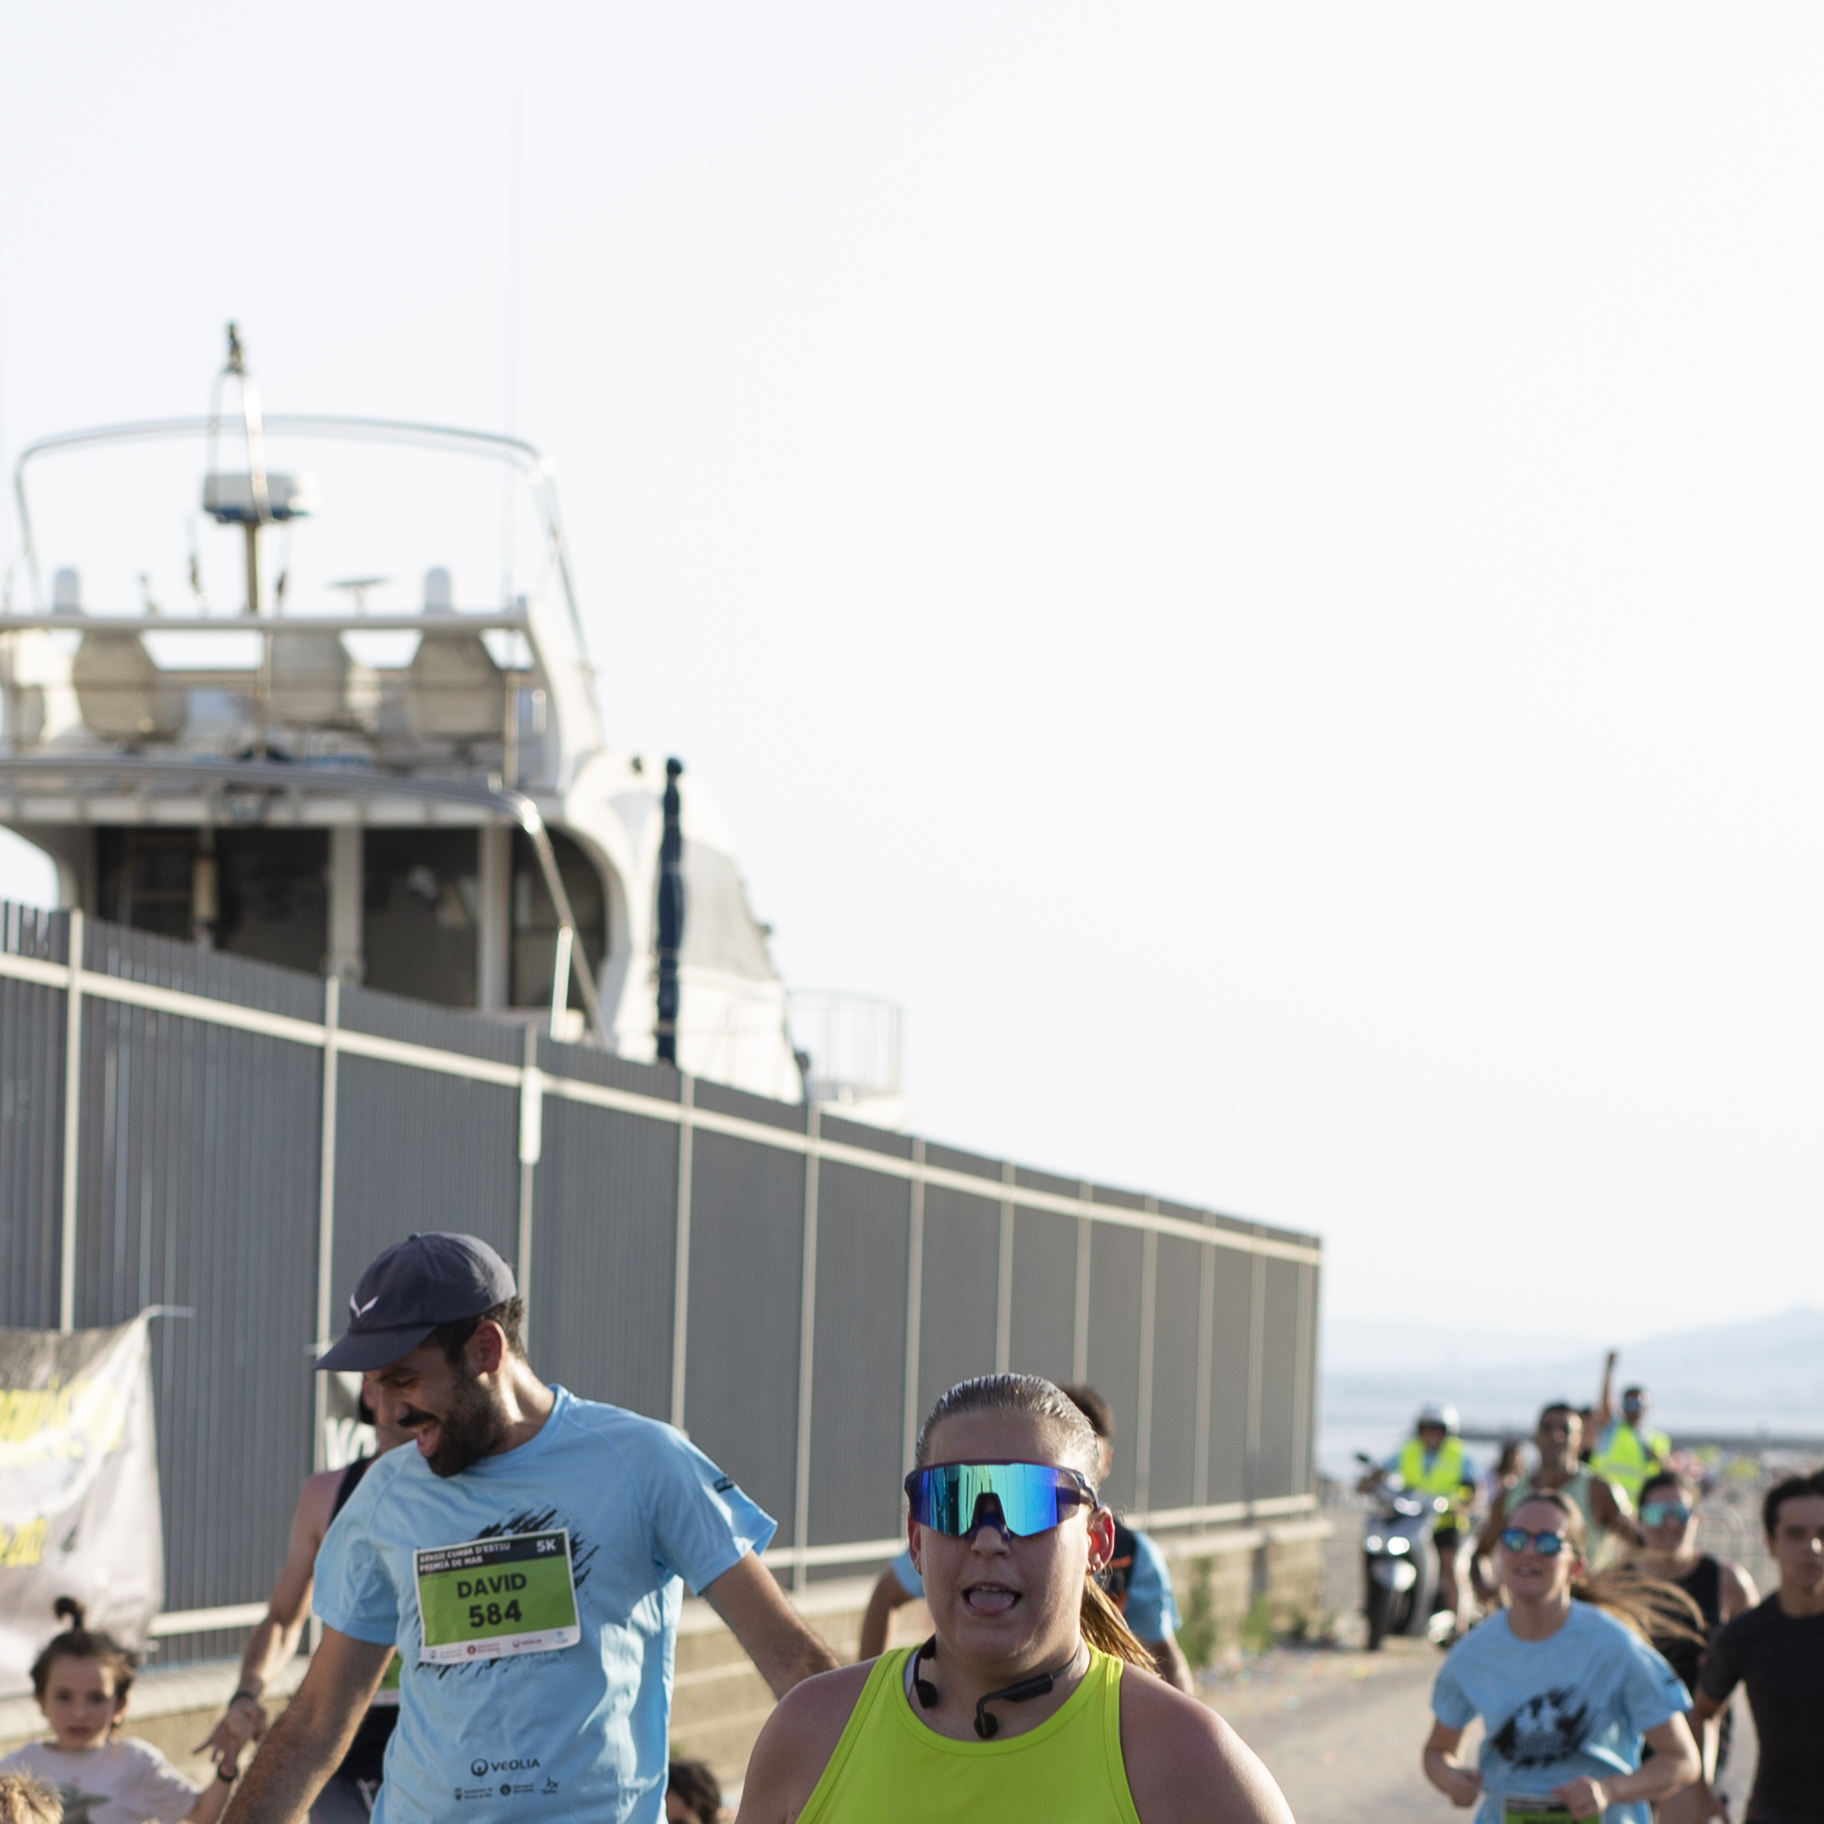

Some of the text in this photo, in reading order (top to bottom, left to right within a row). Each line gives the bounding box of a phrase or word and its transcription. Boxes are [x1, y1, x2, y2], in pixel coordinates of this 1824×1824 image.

[536, 1538, 557, 1553] 5K
[457, 1573, 527, 1599] DAVID
[469, 1600, 522, 1628] 584
[491, 1759, 541, 1772] VEOLIA
